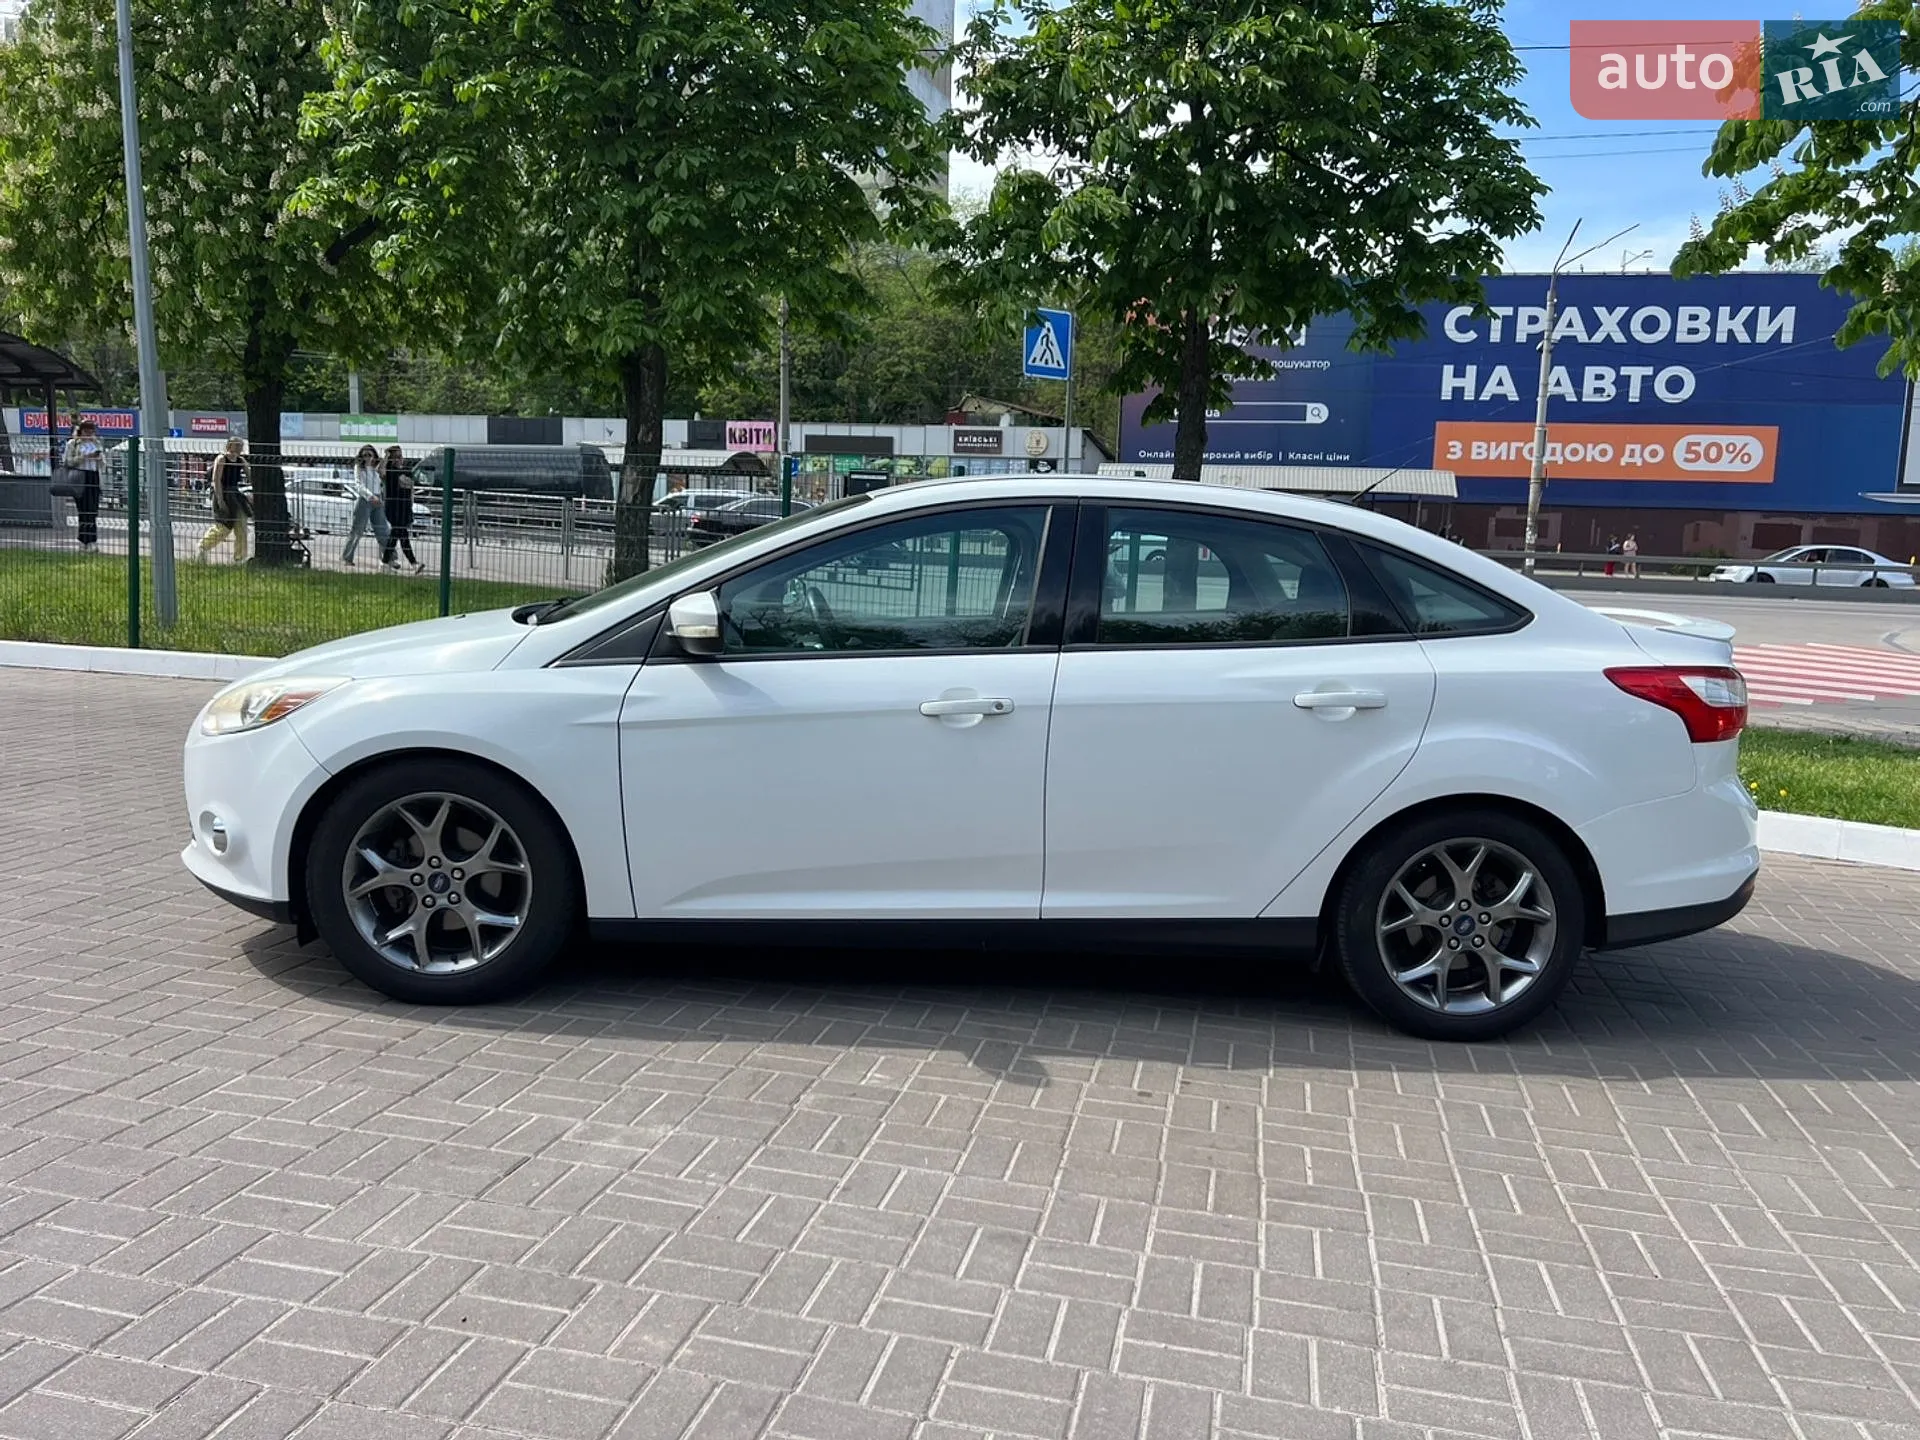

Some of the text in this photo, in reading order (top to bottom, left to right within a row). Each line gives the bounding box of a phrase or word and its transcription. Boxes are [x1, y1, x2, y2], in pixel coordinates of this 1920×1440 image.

[1443, 305, 1796, 344] СТРАХОВКИ
[1271, 359, 1331, 371] пошукатор
[1440, 364, 1697, 403] НА АВТО
[728, 427, 772, 445] КВІТИ
[1203, 450, 1241, 461] ирокий
[1244, 450, 1273, 461] вибір
[1288, 451, 1324, 461] Класні
[1327, 452, 1350, 462] ціни
[1470, 441, 1614, 464] ВИГОДОЮ
[1619, 443, 1665, 467] ДО
[1683, 440, 1753, 465] 50%
